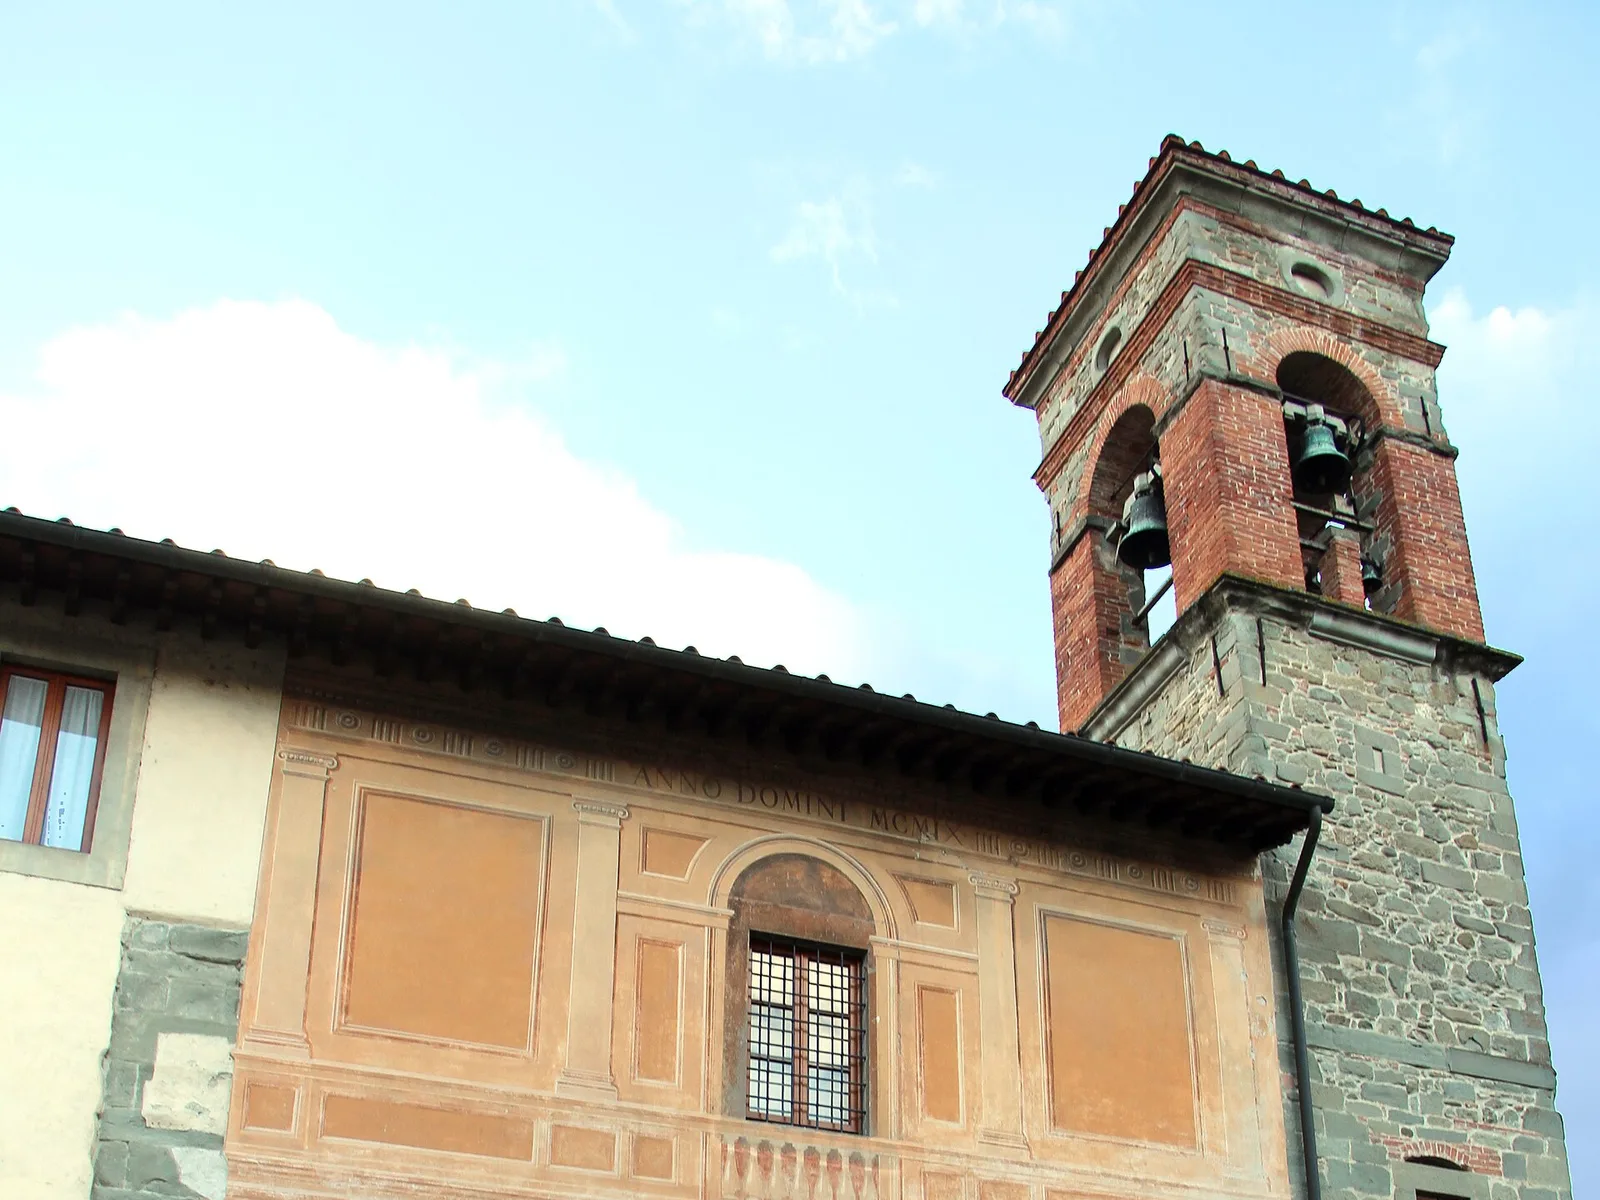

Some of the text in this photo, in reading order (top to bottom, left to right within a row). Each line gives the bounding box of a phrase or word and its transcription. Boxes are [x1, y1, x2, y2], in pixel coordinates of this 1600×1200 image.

[634, 765, 963, 846] ANNO DOMINI MCMIX
